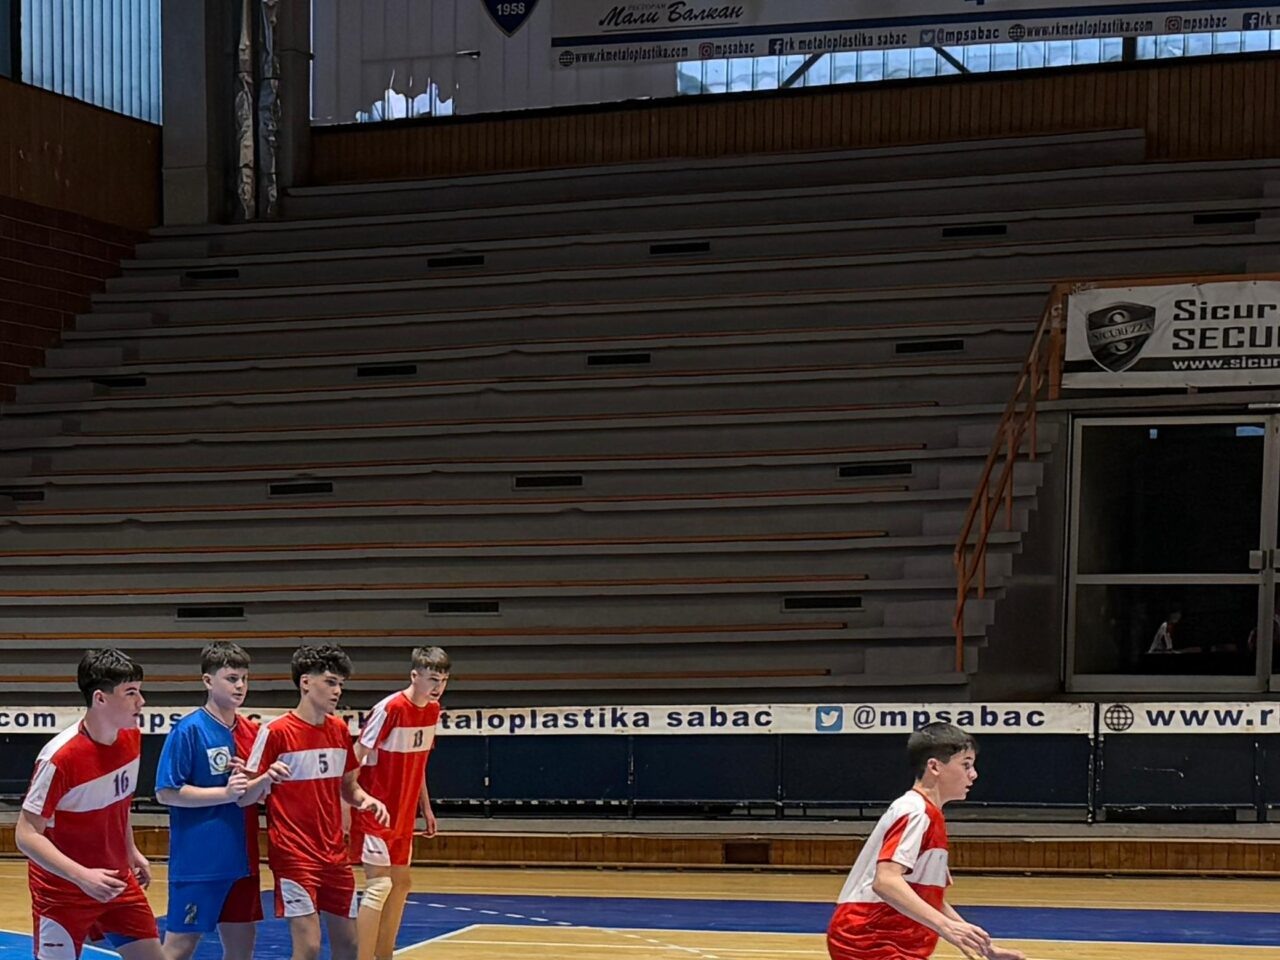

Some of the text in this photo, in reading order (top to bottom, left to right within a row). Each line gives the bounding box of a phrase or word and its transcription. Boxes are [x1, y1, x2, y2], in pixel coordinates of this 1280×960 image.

[1172, 326, 1280, 350] SECU
[667, 706, 773, 727] sabac
[854, 705, 1045, 730] @mpsabac
[318, 753, 329, 773] 5
[113, 770, 129, 797] 16
